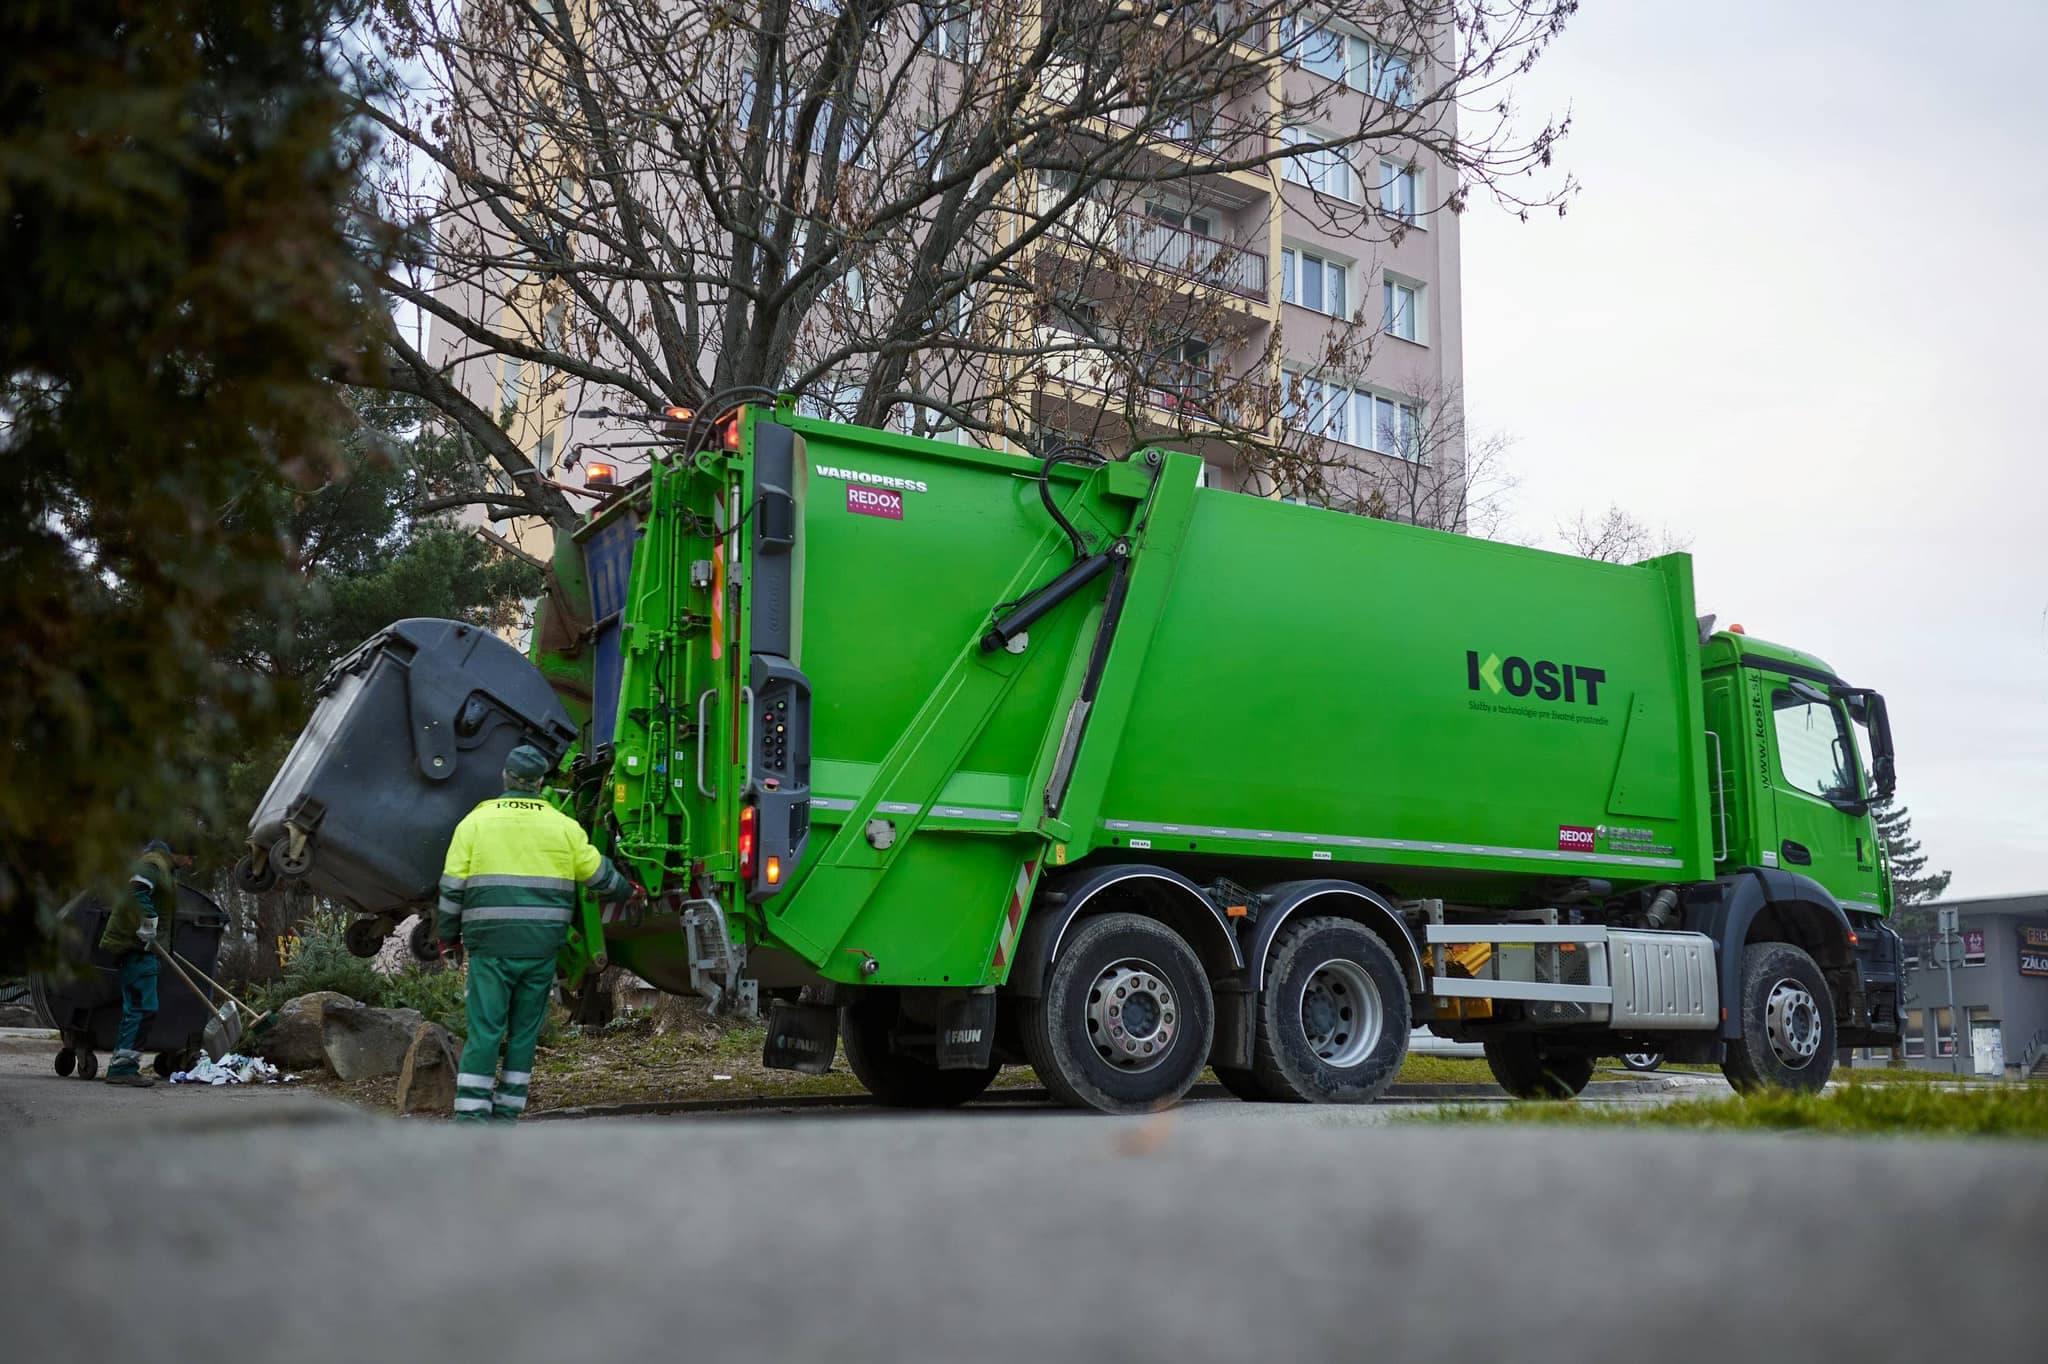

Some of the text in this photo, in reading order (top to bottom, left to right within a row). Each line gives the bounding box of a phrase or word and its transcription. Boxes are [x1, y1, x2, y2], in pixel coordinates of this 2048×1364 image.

[816, 464, 928, 492] VARIOPRESS
[849, 489, 900, 509] REDOX
[1466, 650, 1606, 706] KOSIT
[1749, 674, 1769, 789] www.kosit.sk
[1560, 830, 1594, 843] REDOX
[952, 1029, 982, 1045] FAUN
